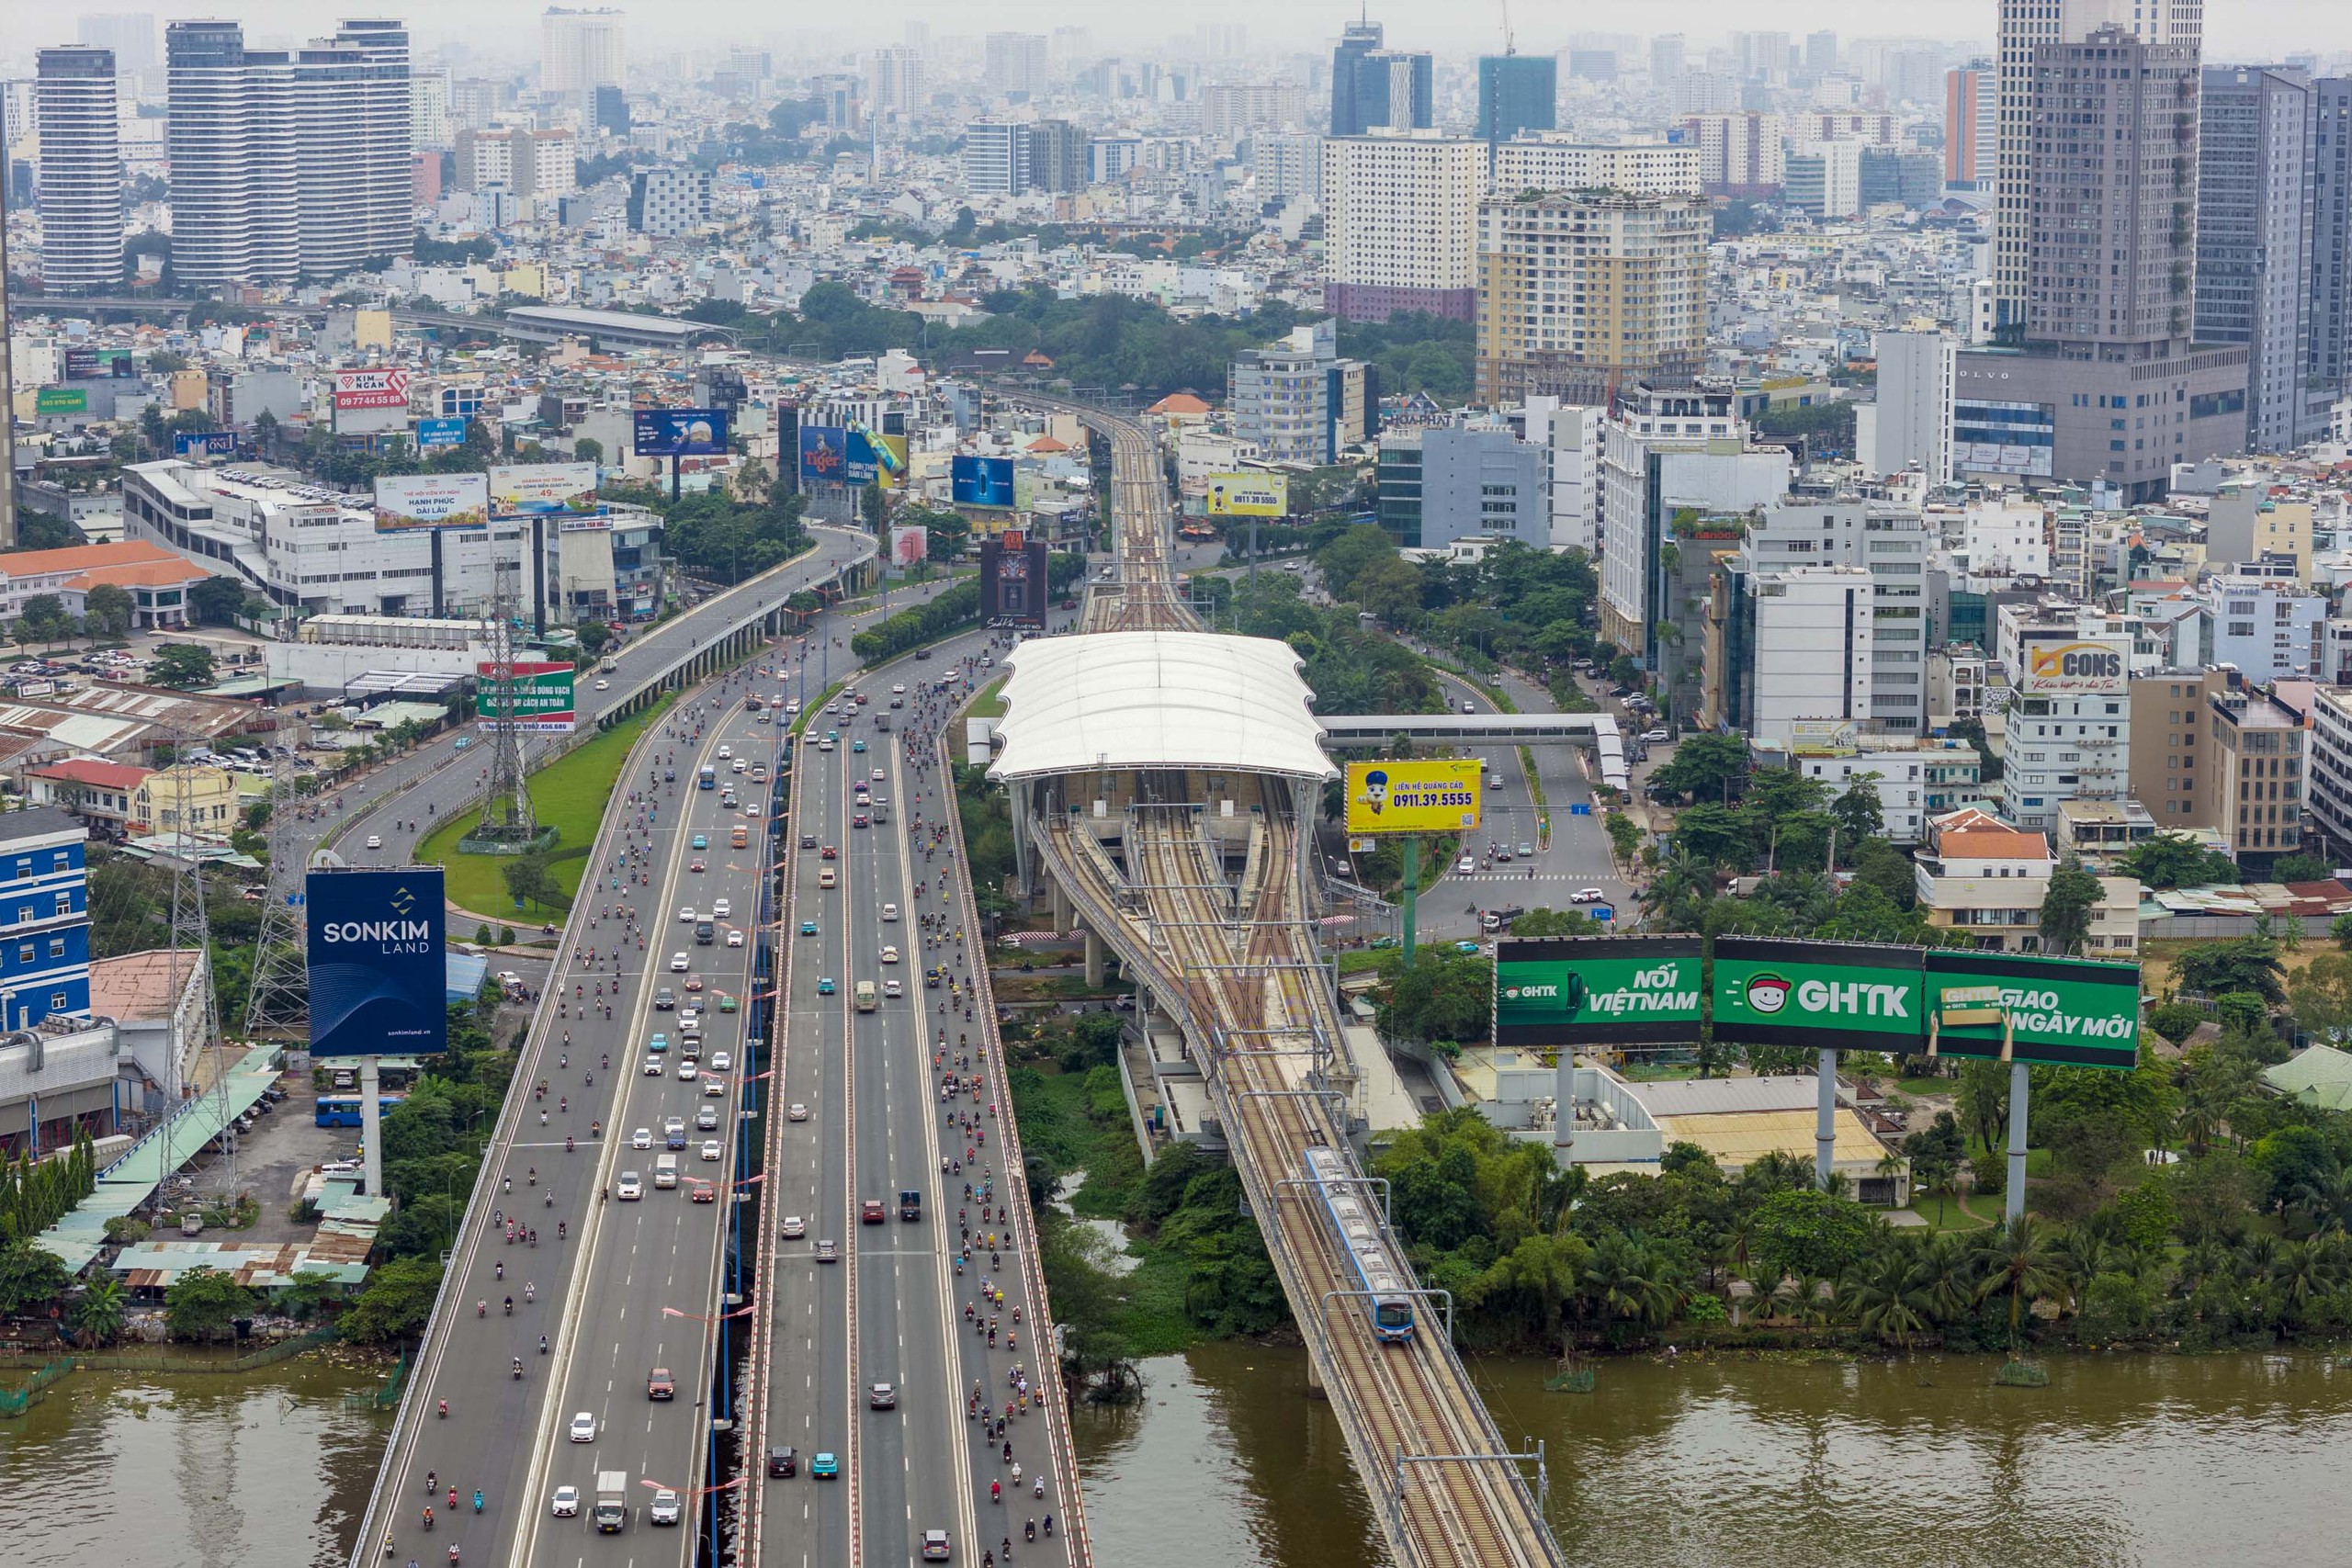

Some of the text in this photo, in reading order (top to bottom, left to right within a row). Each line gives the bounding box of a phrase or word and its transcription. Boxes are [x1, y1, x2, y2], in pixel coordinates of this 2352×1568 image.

[1960, 370, 2009, 379] OLVO
[340, 398, 352, 406] 09
[804, 450, 841, 472] Tiger
[409, 499, 431, 507] HẠNH
[1261, 496, 1277, 504] 5555
[537, 684, 553, 694] ĐÚNG
[555, 686, 570, 696] VẠCH
[539, 698, 548, 706] AN
[549, 697, 565, 706] TOÀN
[1395, 781, 1409, 790] LIÊN
[1412, 782, 1420, 792] HỆ
[1423, 781, 1447, 790] QUẢNG
[1394, 793, 1472, 807] 0911.39.5555
[323, 920, 429, 942] SONKIM
[382, 942, 429, 954] LAND
[1634, 963, 1679, 988] NỐI
[1521, 986, 1557, 998] GHTK
[1798, 979, 1909, 1018] GHTK
[1998, 988, 2059, 1010] GIAO
[2011, 1010, 2133, 1039] NGÀY MỚI
